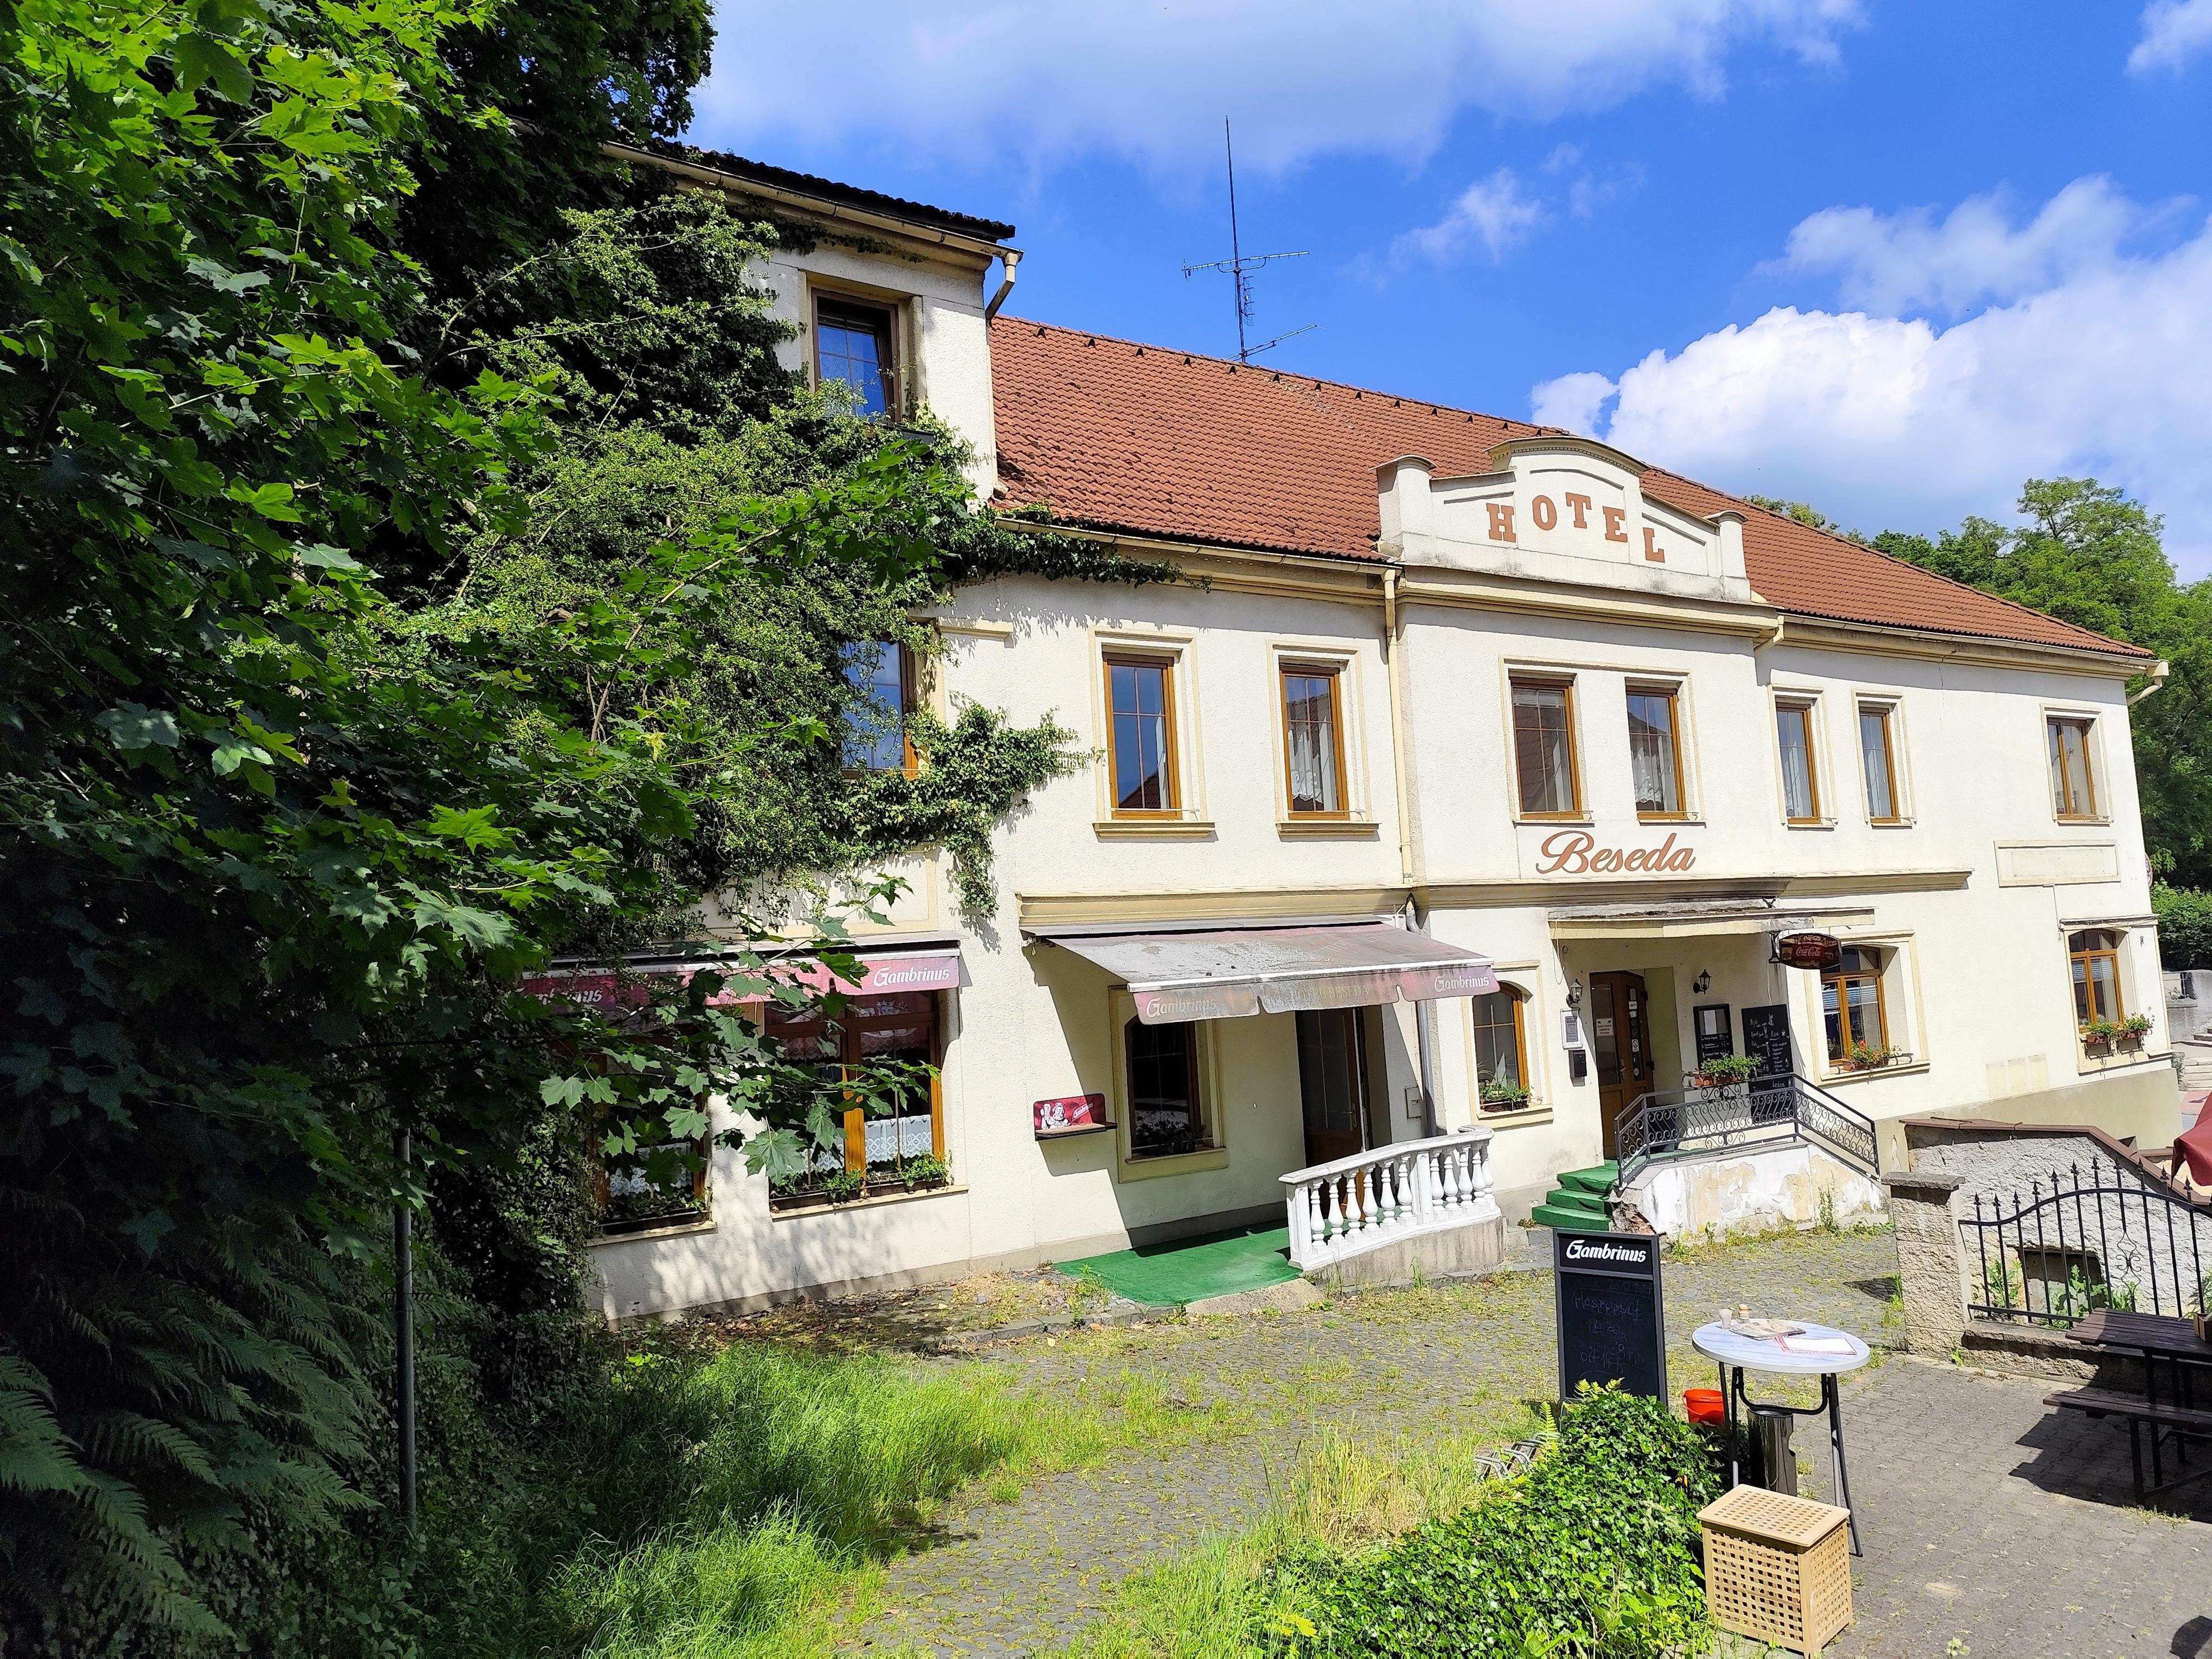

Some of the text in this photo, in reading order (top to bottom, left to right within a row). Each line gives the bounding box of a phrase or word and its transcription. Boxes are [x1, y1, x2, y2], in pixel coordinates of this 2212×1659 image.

[1486, 492, 1665, 563] HOTEL
[1536, 830, 1695, 874] Beseda
[873, 966, 950, 987] Gambrinus
[1434, 974, 1489, 992] Gambrinus
[1327, 985, 1369, 999] BESEDA
[1146, 997, 1217, 1018] Gambrinus
[1566, 1240, 1646, 1262] Gambrinus
